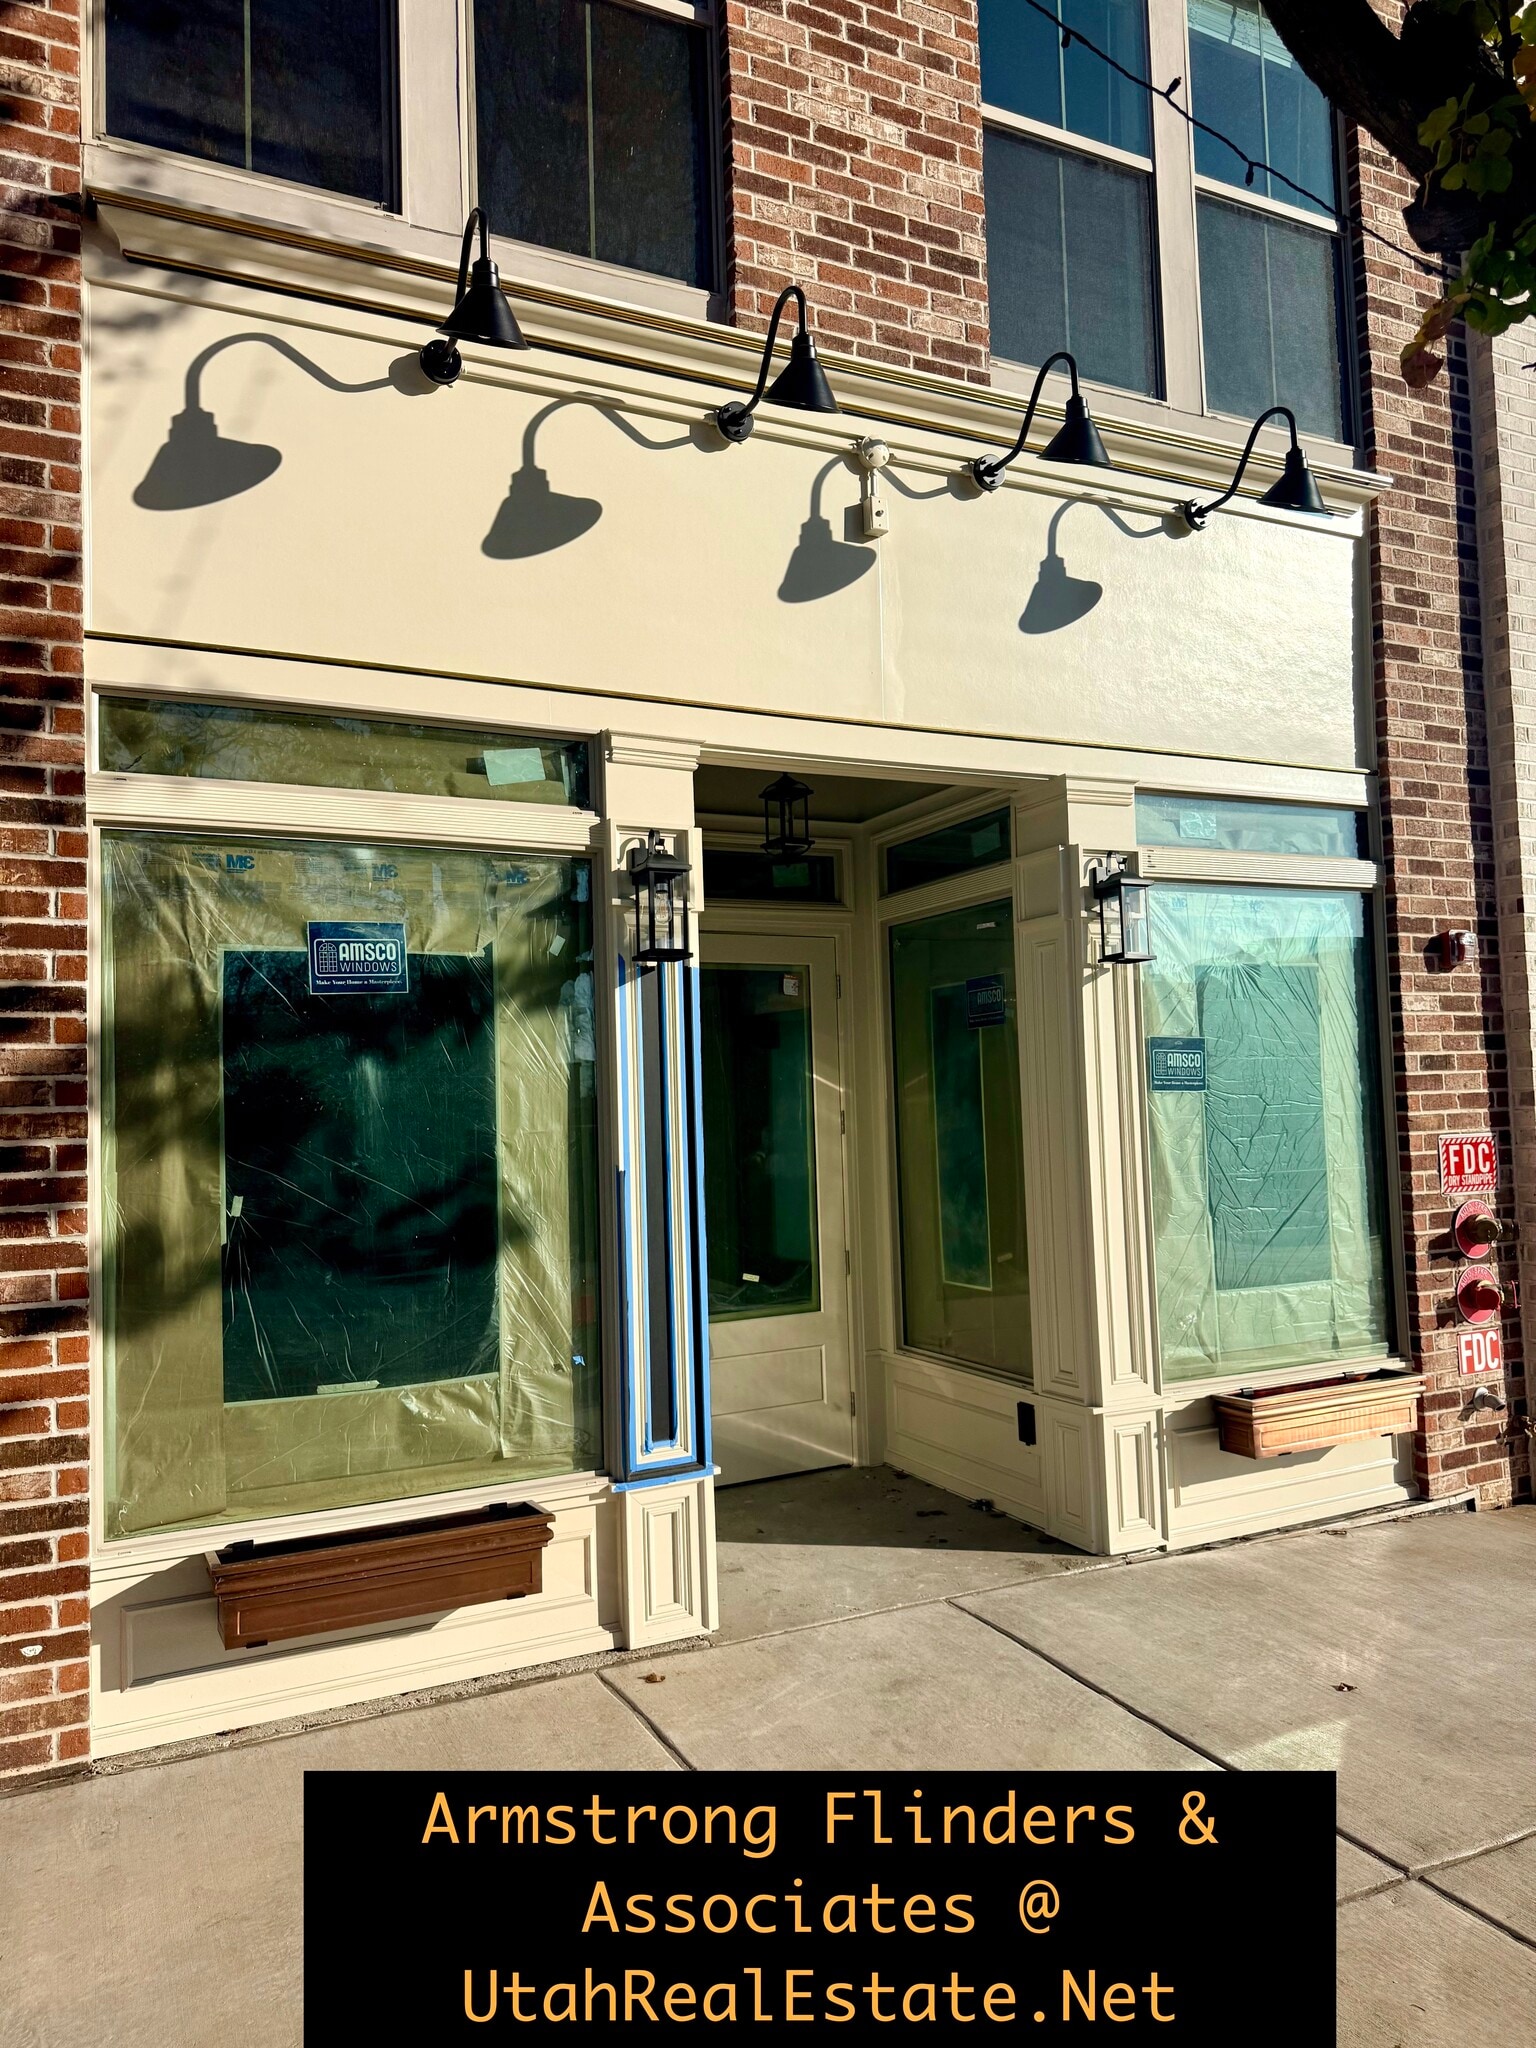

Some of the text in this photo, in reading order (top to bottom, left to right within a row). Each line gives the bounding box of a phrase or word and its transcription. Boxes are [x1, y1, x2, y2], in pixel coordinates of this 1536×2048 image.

[339, 943, 397, 961] AMSCO
[340, 961, 397, 972] WINDOWS
[977, 988, 1001, 1005] AMSCO
[1167, 1052, 1201, 1068] AMSCO
[1167, 1067, 1202, 1077] WINDOWS
[1449, 1143, 1491, 1175] FDC
[1448, 1175, 1460, 1187] DRY
[1461, 1173, 1493, 1186] STANDPIPE
[1460, 1330, 1499, 1374] FDC
